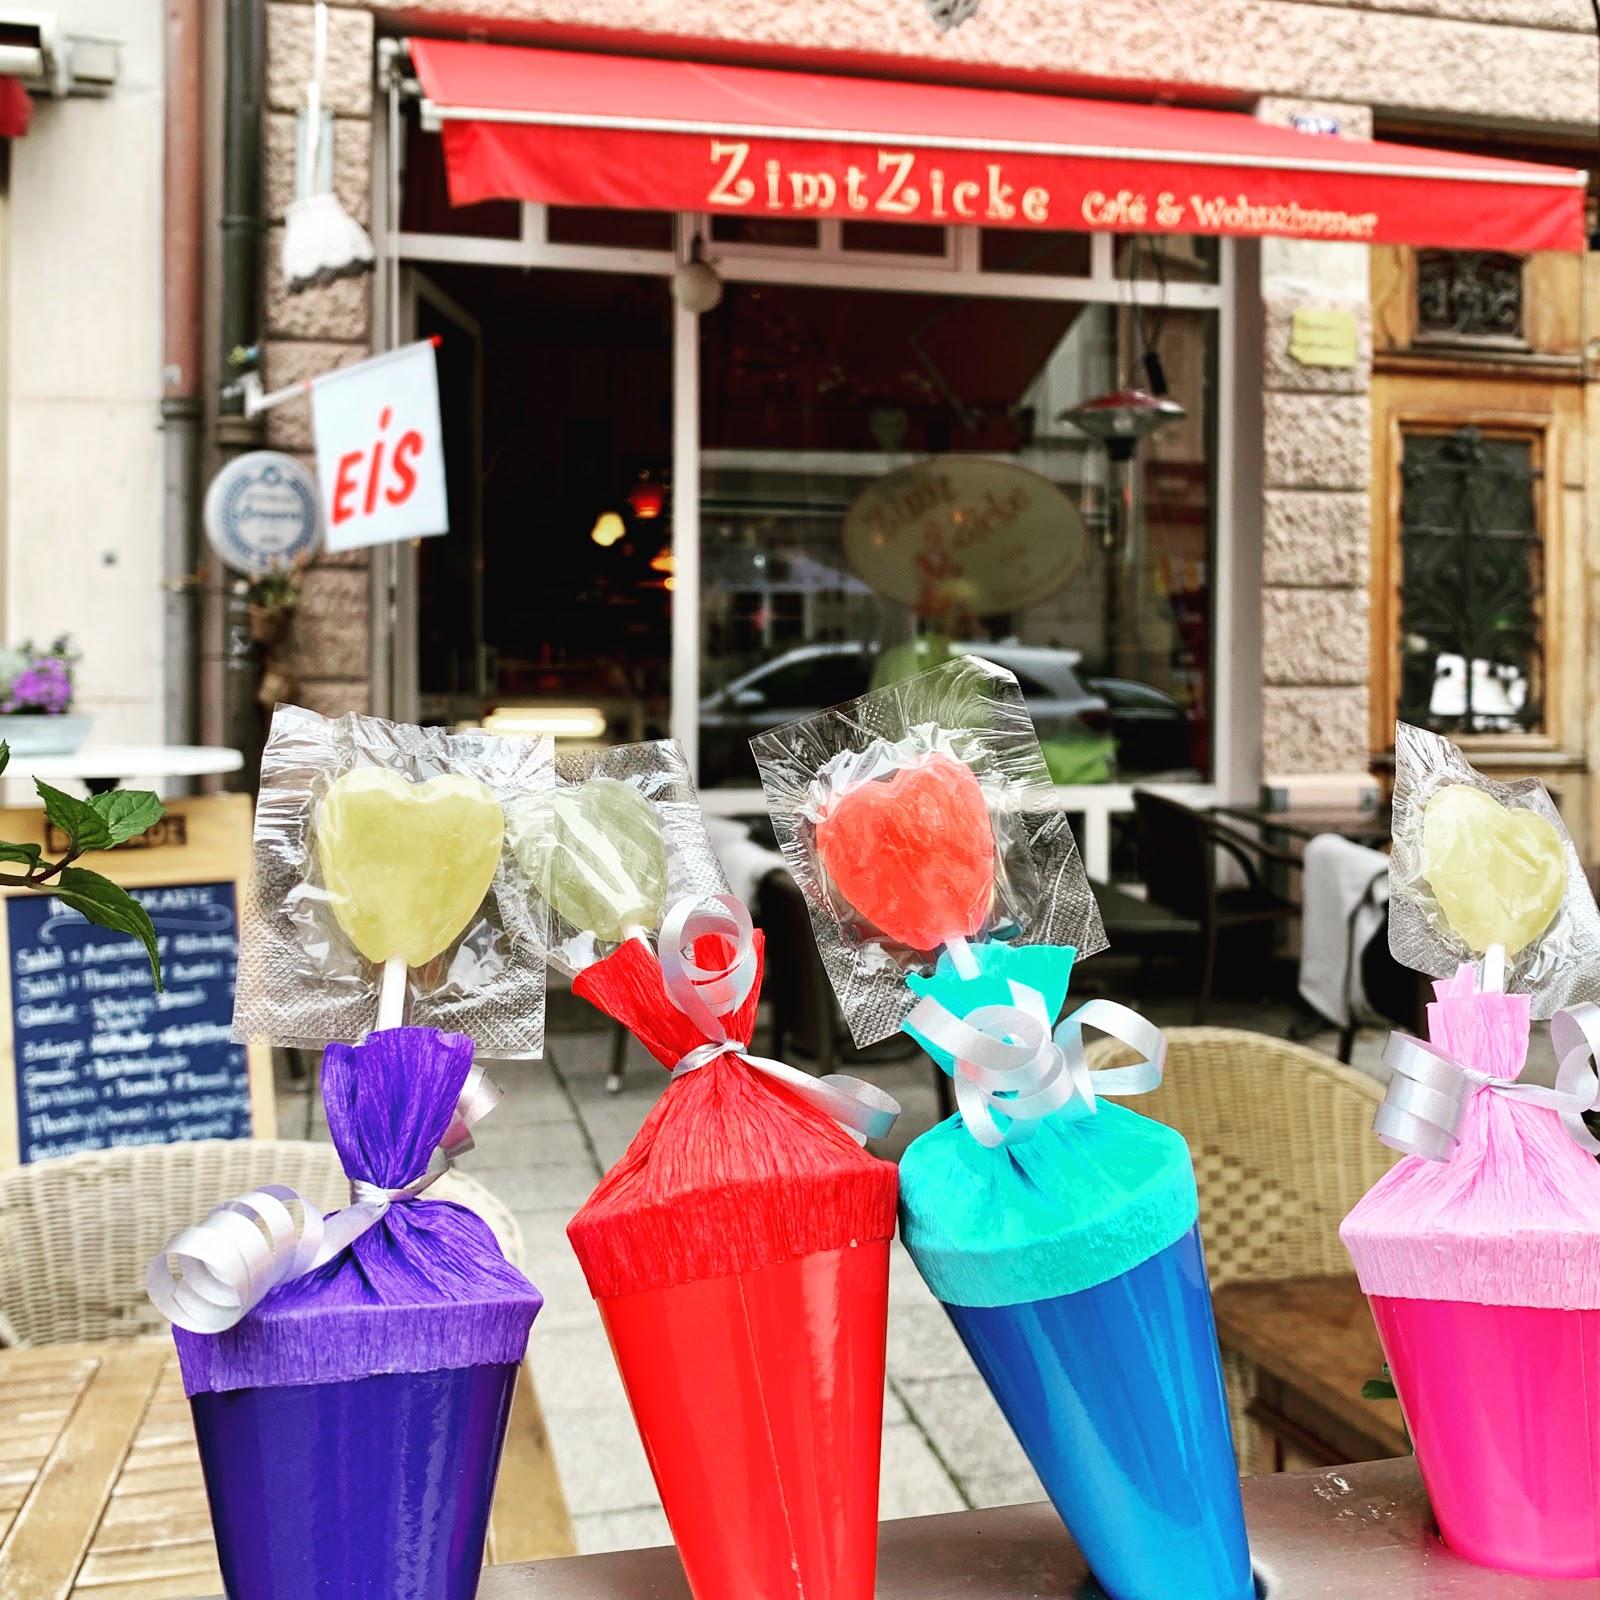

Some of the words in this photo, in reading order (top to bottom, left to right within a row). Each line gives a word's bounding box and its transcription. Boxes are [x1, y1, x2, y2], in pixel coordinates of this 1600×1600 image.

[708, 139, 1050, 222] ZimtZicke
[1081, 189, 1148, 225] Café
[1154, 190, 1186, 227] &
